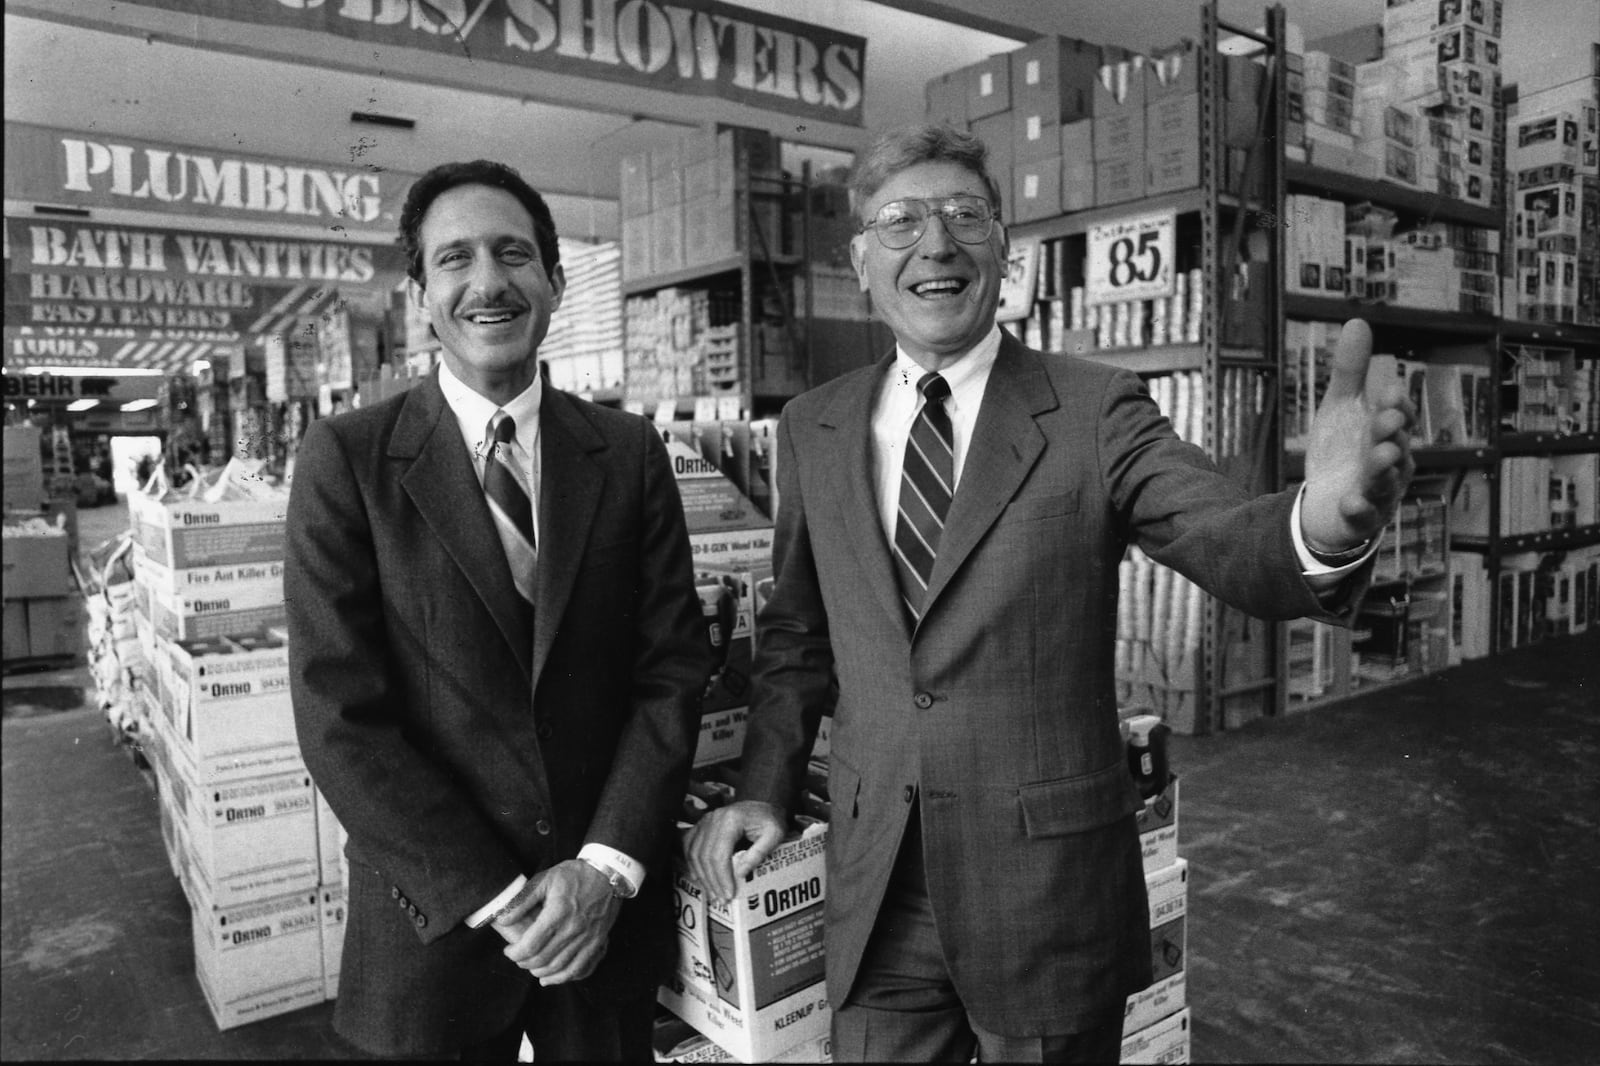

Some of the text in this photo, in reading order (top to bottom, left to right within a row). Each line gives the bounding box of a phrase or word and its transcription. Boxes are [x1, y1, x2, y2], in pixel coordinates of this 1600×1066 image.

[61, 138, 381, 222] PLUMBING
[29, 226, 374, 283] BATH VANITIES
[30, 273, 253, 307] HARDWARE
[32, 303, 231, 329] FASTENERS
[3, 376, 74, 397] BEHR
[764, 877, 821, 918] ORTHO
